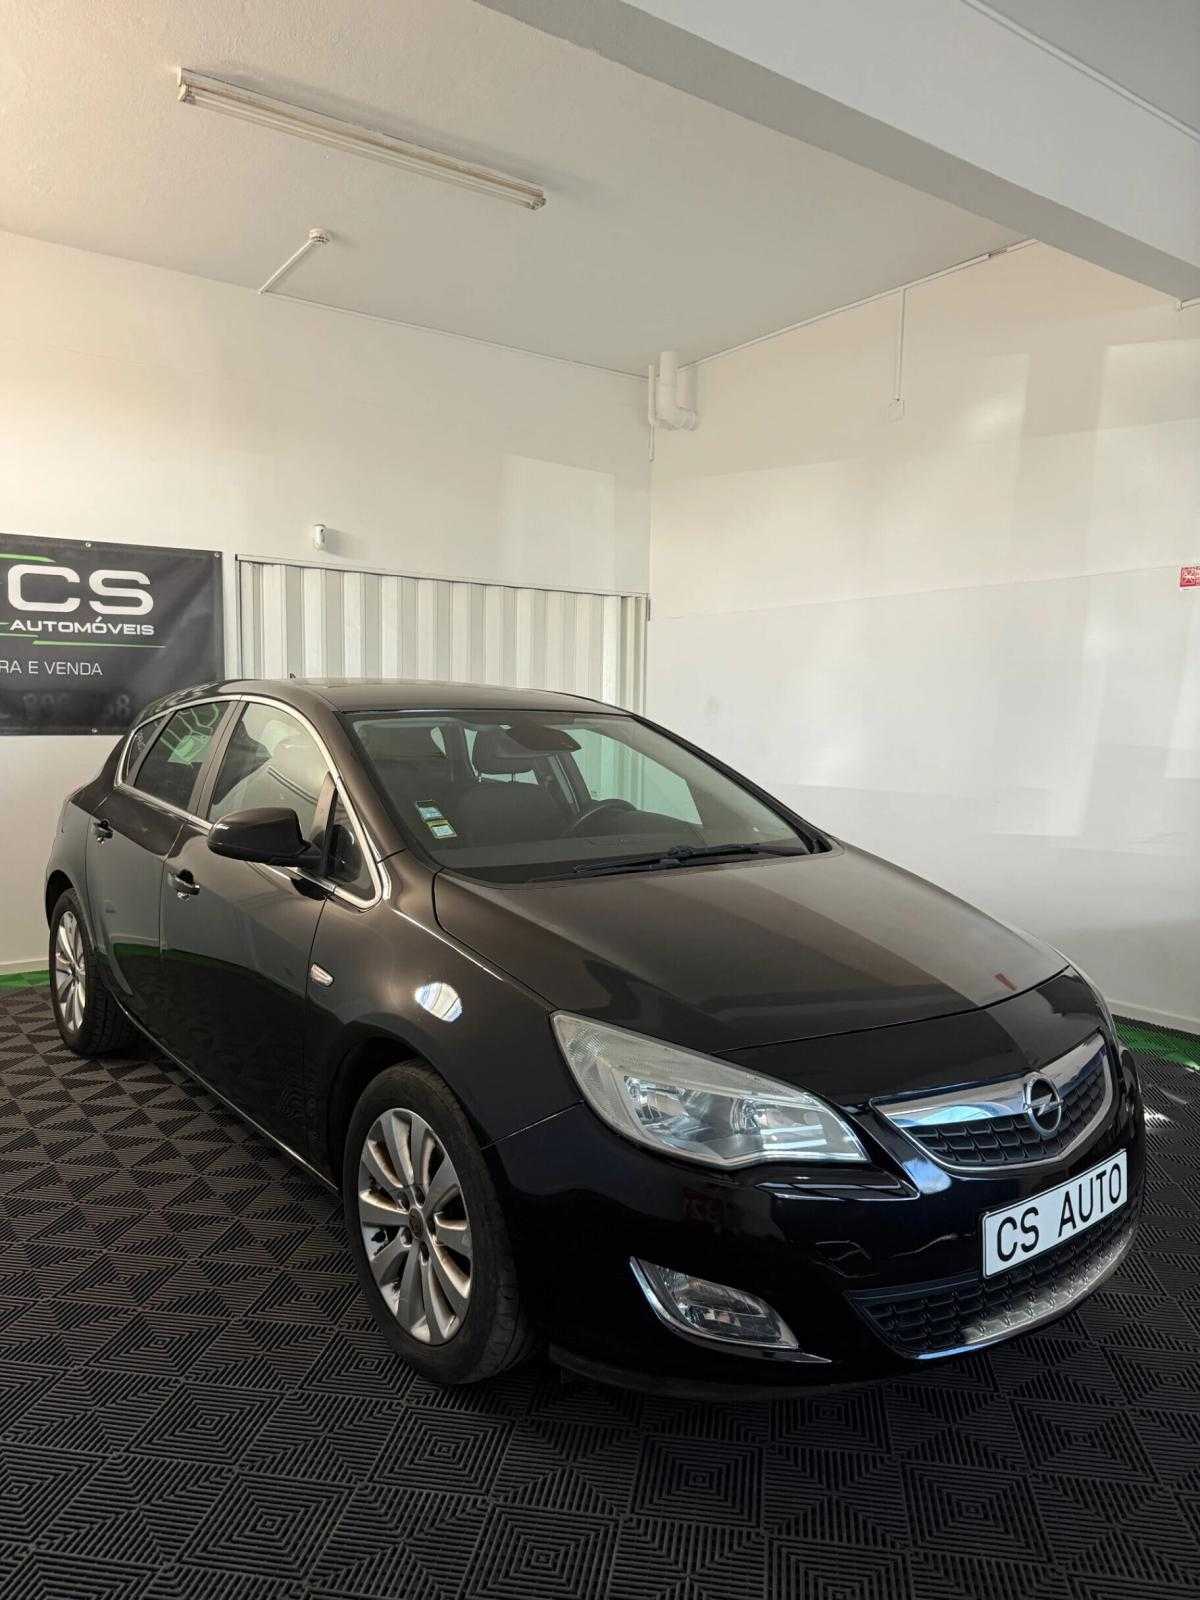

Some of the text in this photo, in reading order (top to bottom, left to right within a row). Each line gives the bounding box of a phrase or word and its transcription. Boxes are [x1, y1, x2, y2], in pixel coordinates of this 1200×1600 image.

[7, 564, 154, 616] CS
[9, 616, 155, 636] AUTOMÓVEIS
[28, 660, 39, 674] E
[44, 661, 103, 676] VENDA
[996, 1163, 1122, 1262] CS AUTO
